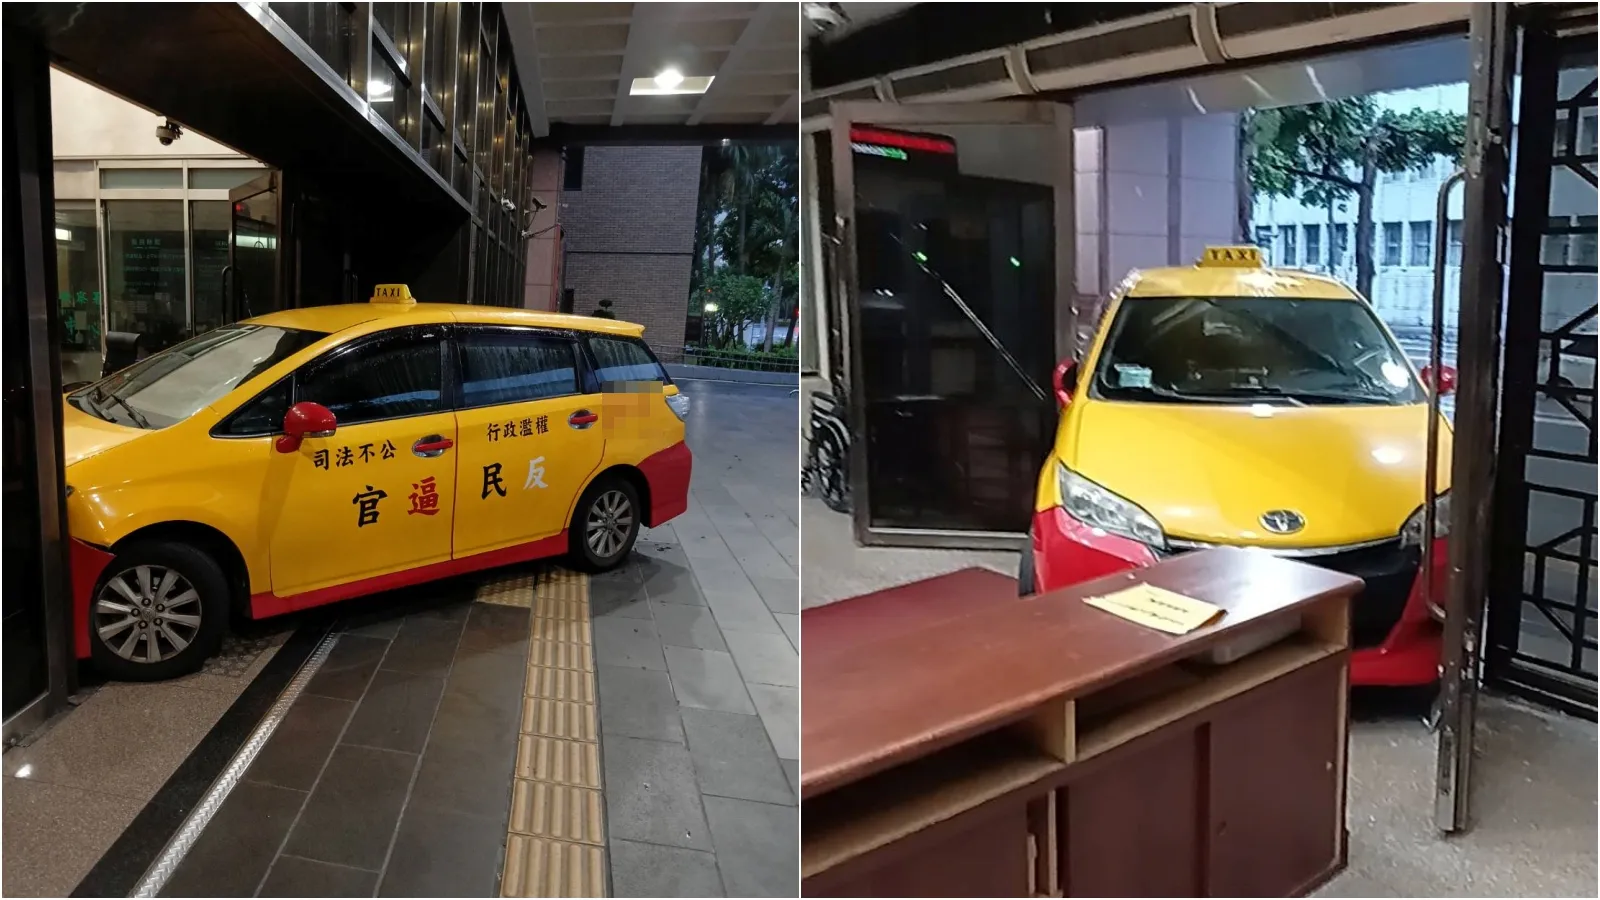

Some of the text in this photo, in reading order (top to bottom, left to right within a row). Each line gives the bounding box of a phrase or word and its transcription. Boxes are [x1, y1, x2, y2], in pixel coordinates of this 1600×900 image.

[1209, 249, 1257, 261] TAXI
[376, 287, 400, 298] TAXI
[487, 415, 549, 442] 行政濫權
[313, 439, 397, 471] 司法不公
